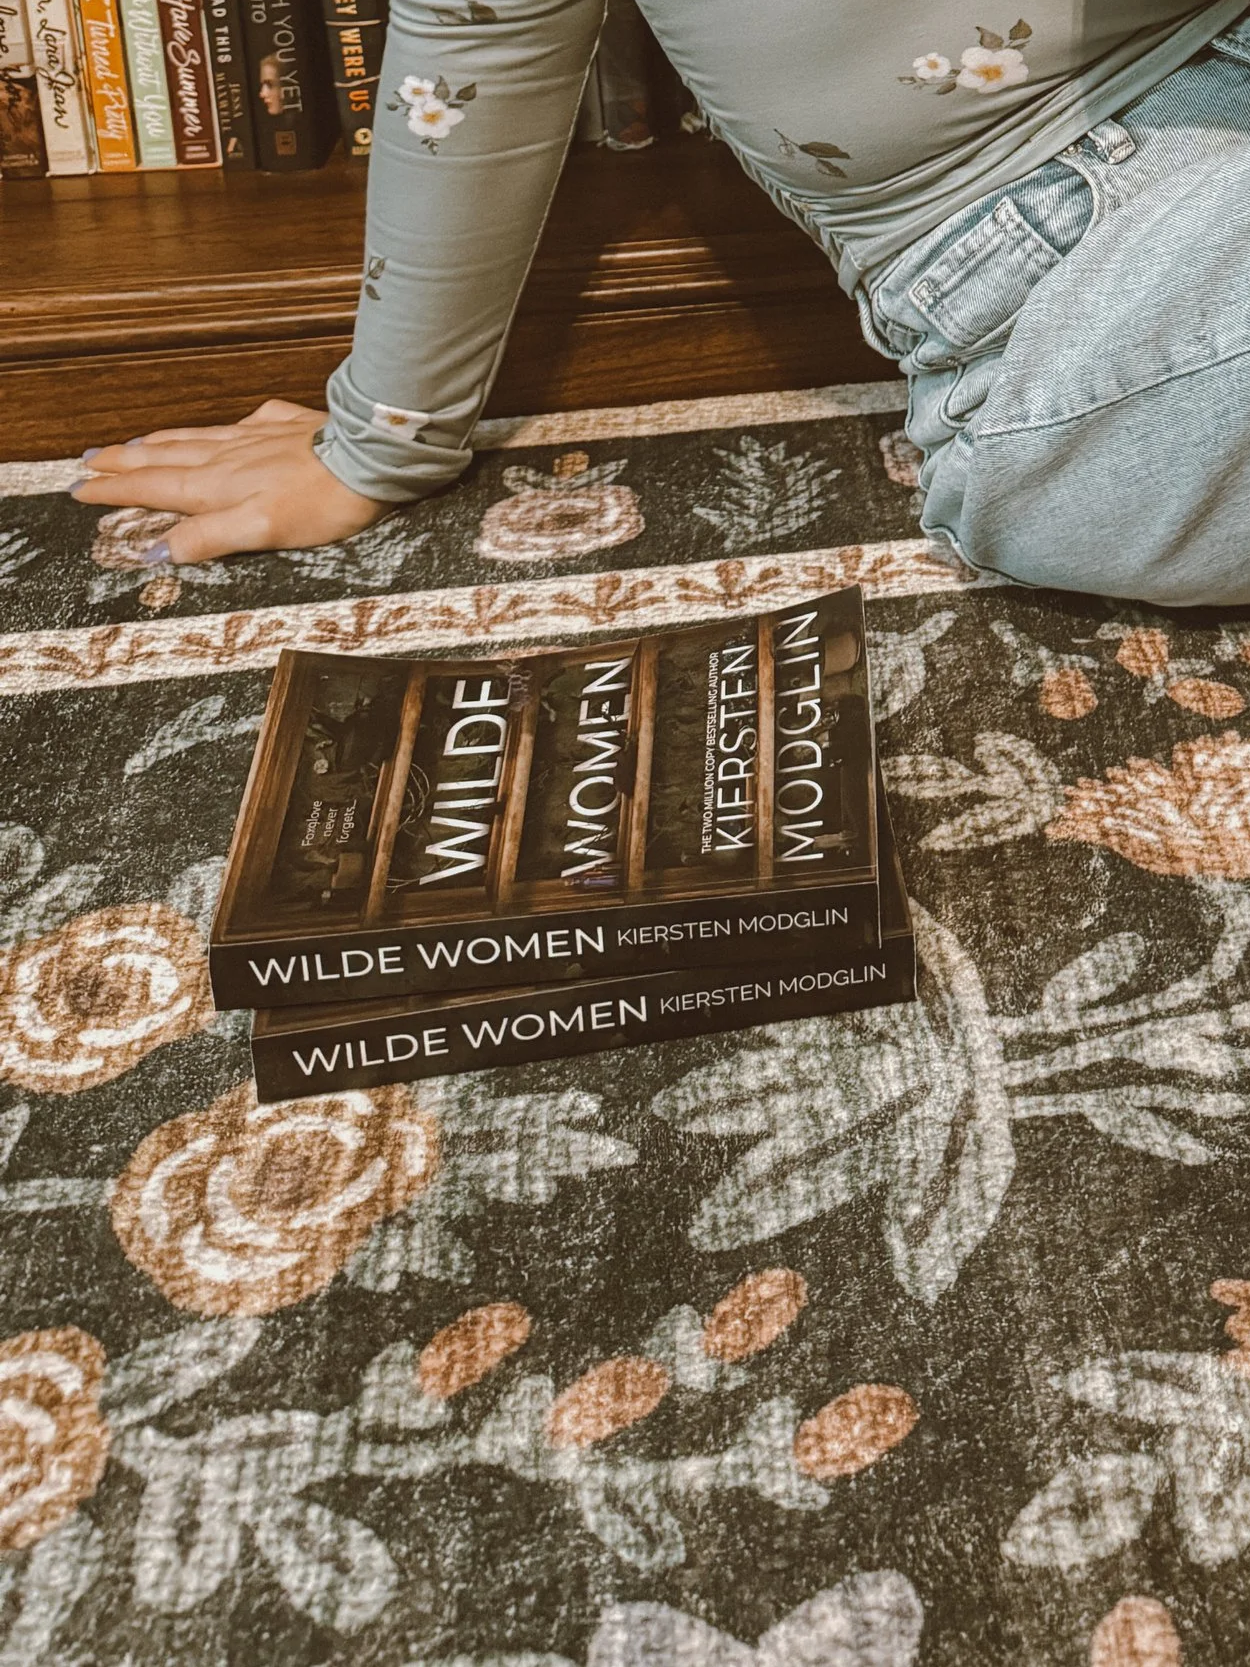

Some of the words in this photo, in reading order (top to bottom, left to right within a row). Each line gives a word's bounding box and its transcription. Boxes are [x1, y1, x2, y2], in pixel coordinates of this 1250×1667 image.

[215, 25, 232, 65] THIS
[273, 13, 297, 65] YOU
[339, 26, 367, 80] WERE
[419, 678, 513, 885] WILDE
[562, 658, 633, 878] WOMEN
[715, 645, 755, 851] KIERSTEN
[776, 610, 825, 863] MODGLIN
[249, 945, 405, 987] WILDE
[417, 925, 605, 973] WOMEN
[617, 917, 732, 947] KIERSTEN
[737, 908, 849, 931] MODGLIN
[292, 1027, 448, 1076] WILDE
[462, 996, 649, 1050] WOMEN
[659, 980, 773, 1014] KIERSTEN
[778, 963, 887, 995] MODGLIN
